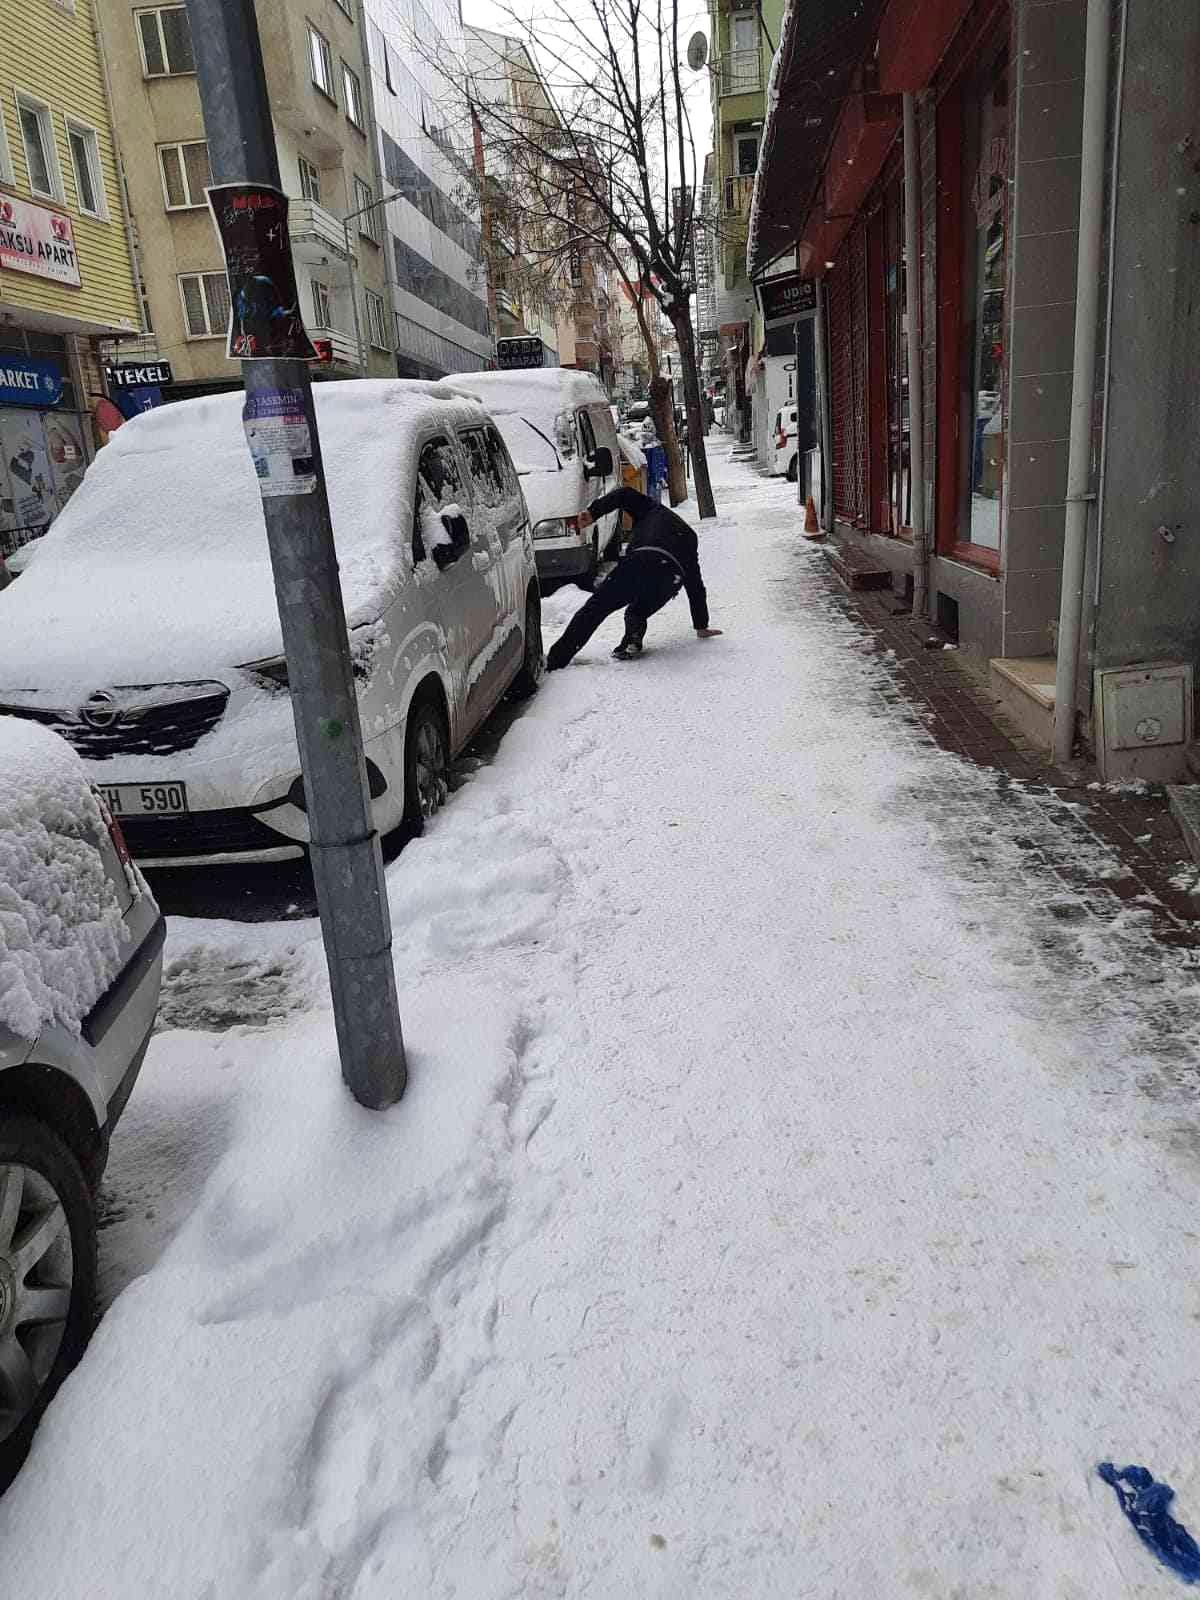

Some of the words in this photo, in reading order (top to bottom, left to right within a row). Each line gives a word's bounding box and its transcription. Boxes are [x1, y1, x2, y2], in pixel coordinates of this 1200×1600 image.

[38, 241, 75, 267] APART
[115, 366, 169, 386] TEKEL
[141, 786, 182, 811] 590
